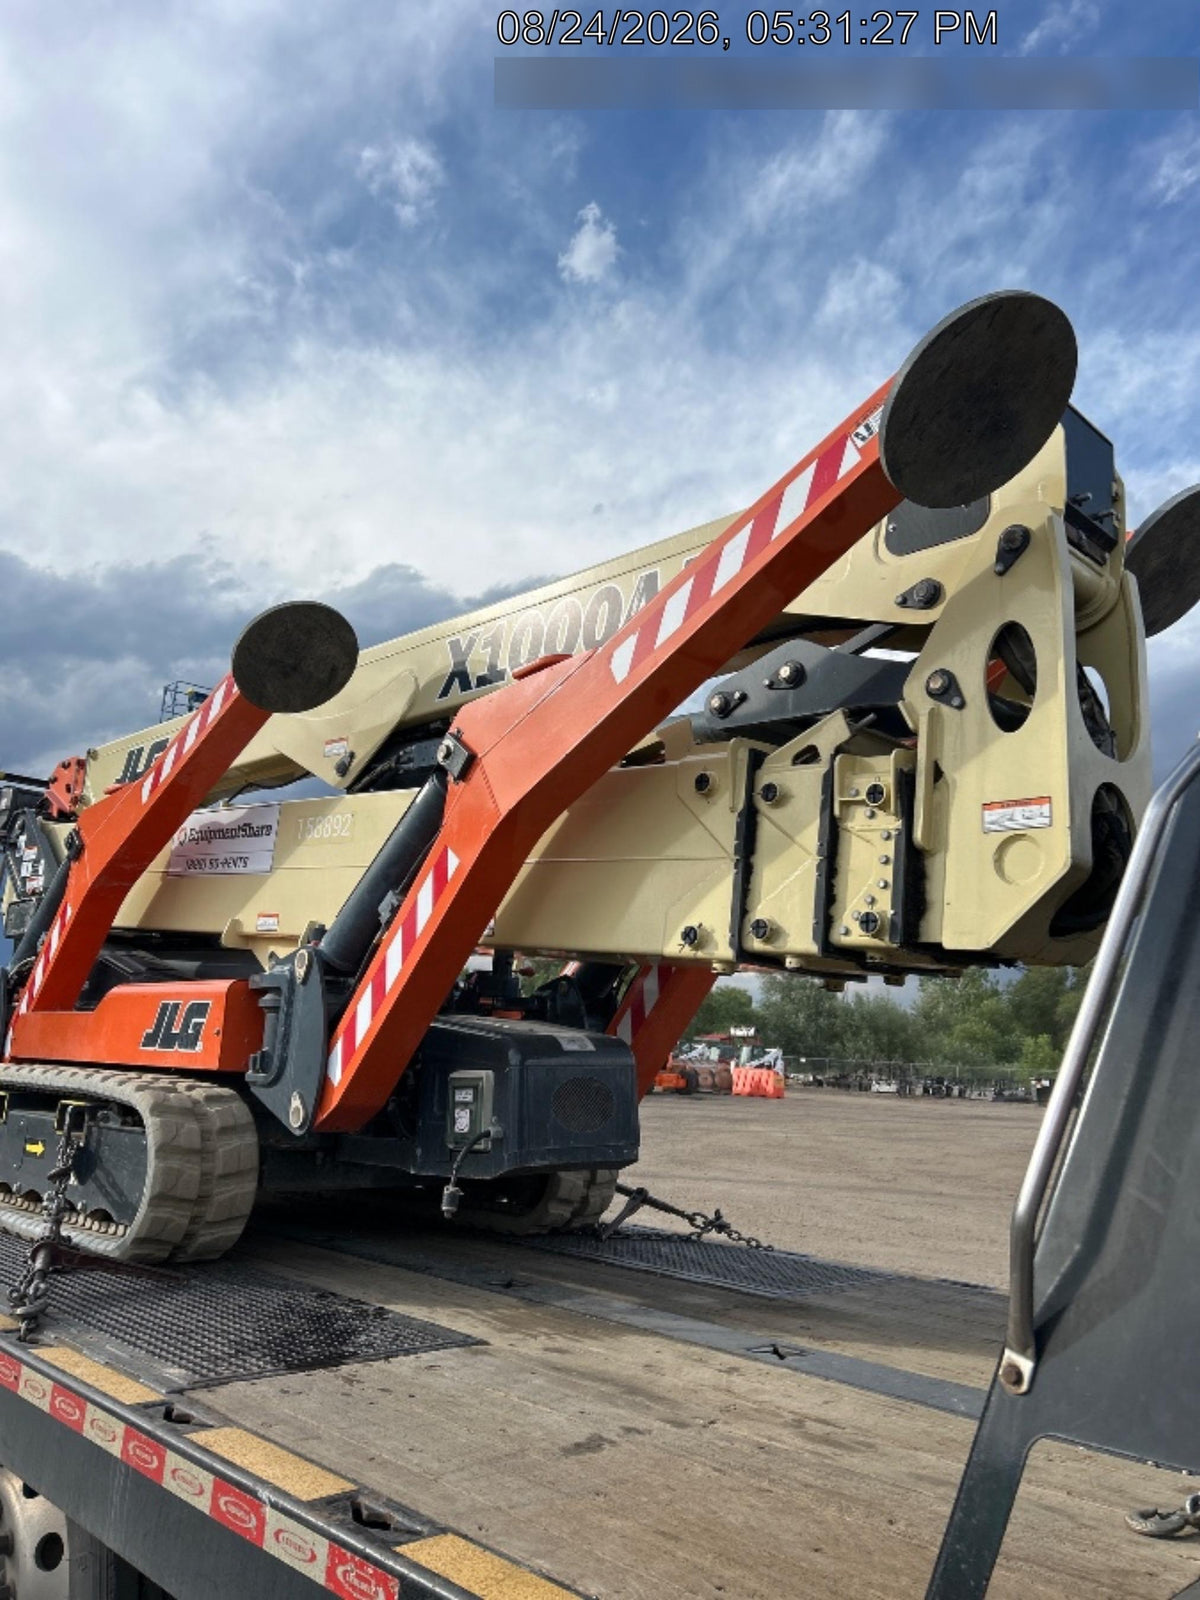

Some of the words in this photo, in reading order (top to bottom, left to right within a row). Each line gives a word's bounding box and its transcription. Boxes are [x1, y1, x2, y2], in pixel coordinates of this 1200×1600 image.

[434, 555, 701, 702] X1000A
[188, 822, 273, 845] EquipmentShare
[139, 1000, 211, 1053] JLG
